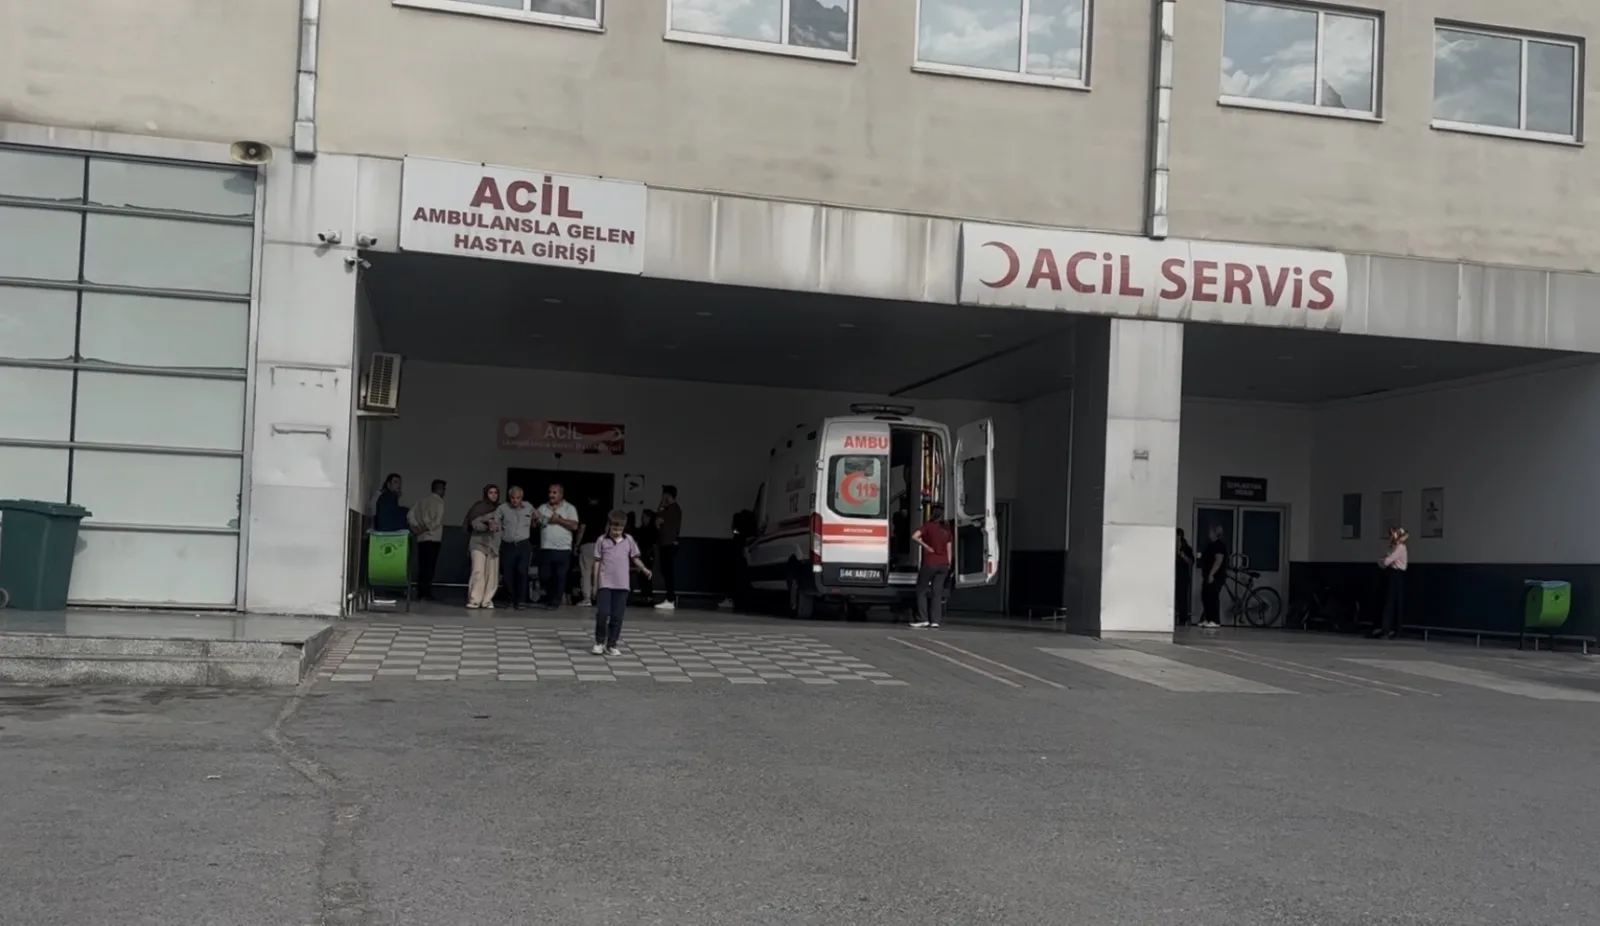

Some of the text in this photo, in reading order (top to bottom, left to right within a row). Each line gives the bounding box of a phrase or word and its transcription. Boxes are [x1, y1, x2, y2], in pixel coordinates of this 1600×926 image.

[469, 175, 584, 219] ACİL
[412, 206, 636, 245] AMBULANSLA GELEN
[453, 233, 596, 264] HASTA GİRİŞİ
[843, 435, 889, 449] AMBU
